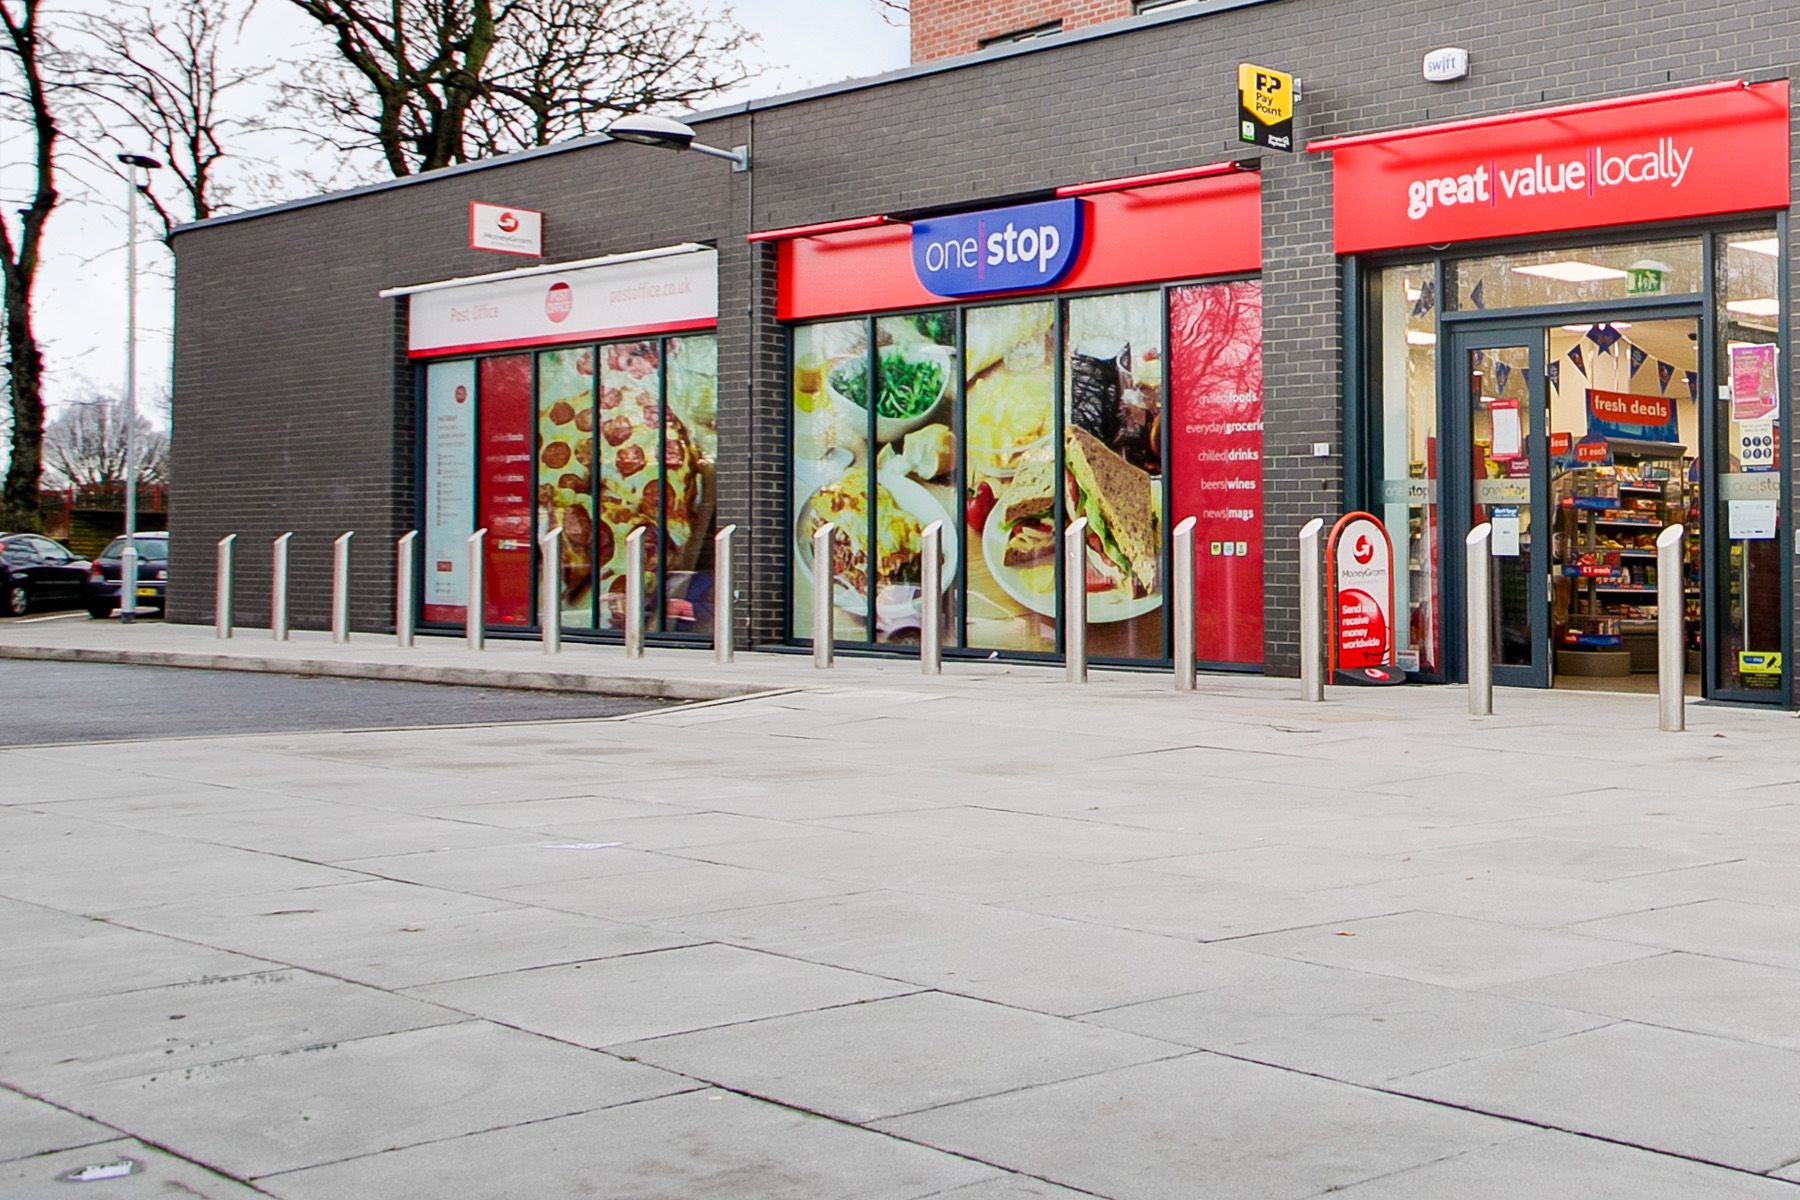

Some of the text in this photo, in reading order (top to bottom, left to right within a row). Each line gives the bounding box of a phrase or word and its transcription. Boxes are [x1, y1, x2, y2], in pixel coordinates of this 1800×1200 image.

[1256, 92, 1273, 106] Pay
[1256, 102, 1281, 116] Point
[1407, 137, 1693, 220] great value locally
[926, 222, 1060, 272] one stop
[1594, 395, 1668, 417] fresh deals
[1186, 419, 1264, 435] everyday grocerie
[1198, 448, 1259, 461] chilled drinks
[1201, 477, 1256, 490] beers wines
[1203, 509, 1254, 521] news mags
[1342, 637, 1380, 650] worldwide
